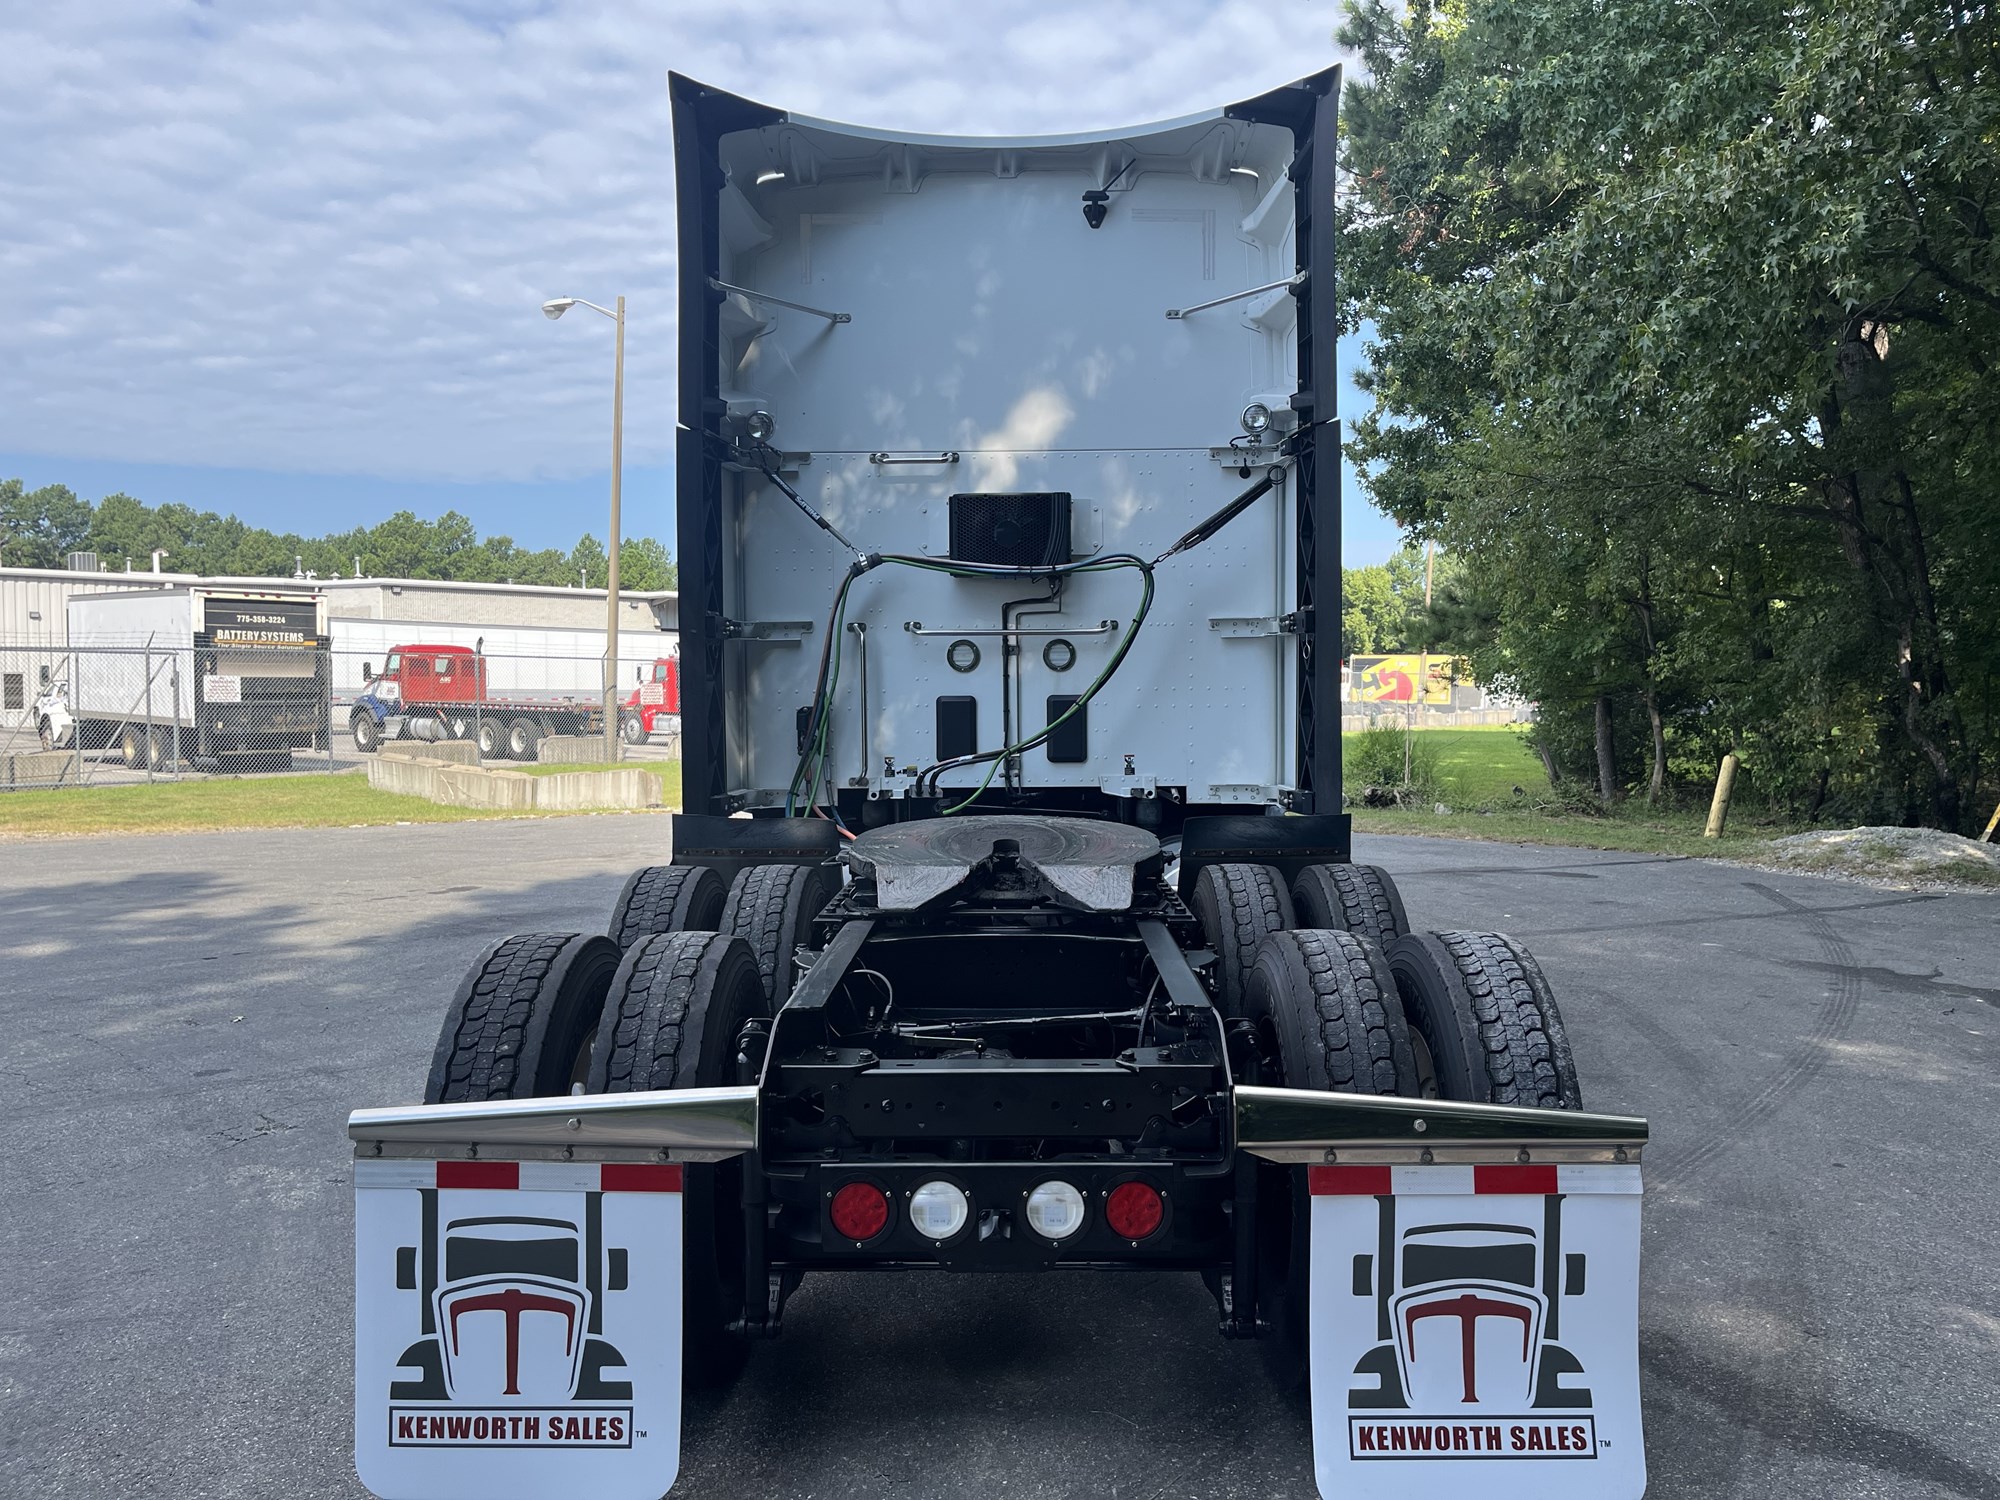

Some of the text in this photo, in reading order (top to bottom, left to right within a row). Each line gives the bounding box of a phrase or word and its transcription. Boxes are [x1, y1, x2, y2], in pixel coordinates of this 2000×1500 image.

[236, 614, 286, 624] 775-358-3224
[216, 629, 304, 643] BATTERY SYSTEMS
[398, 1416, 540, 1440] KENWORTH
[548, 1416, 624, 1441] SALES
[1358, 1426, 1502, 1451] KENWORTH
[1510, 1426, 1588, 1451] SALES
